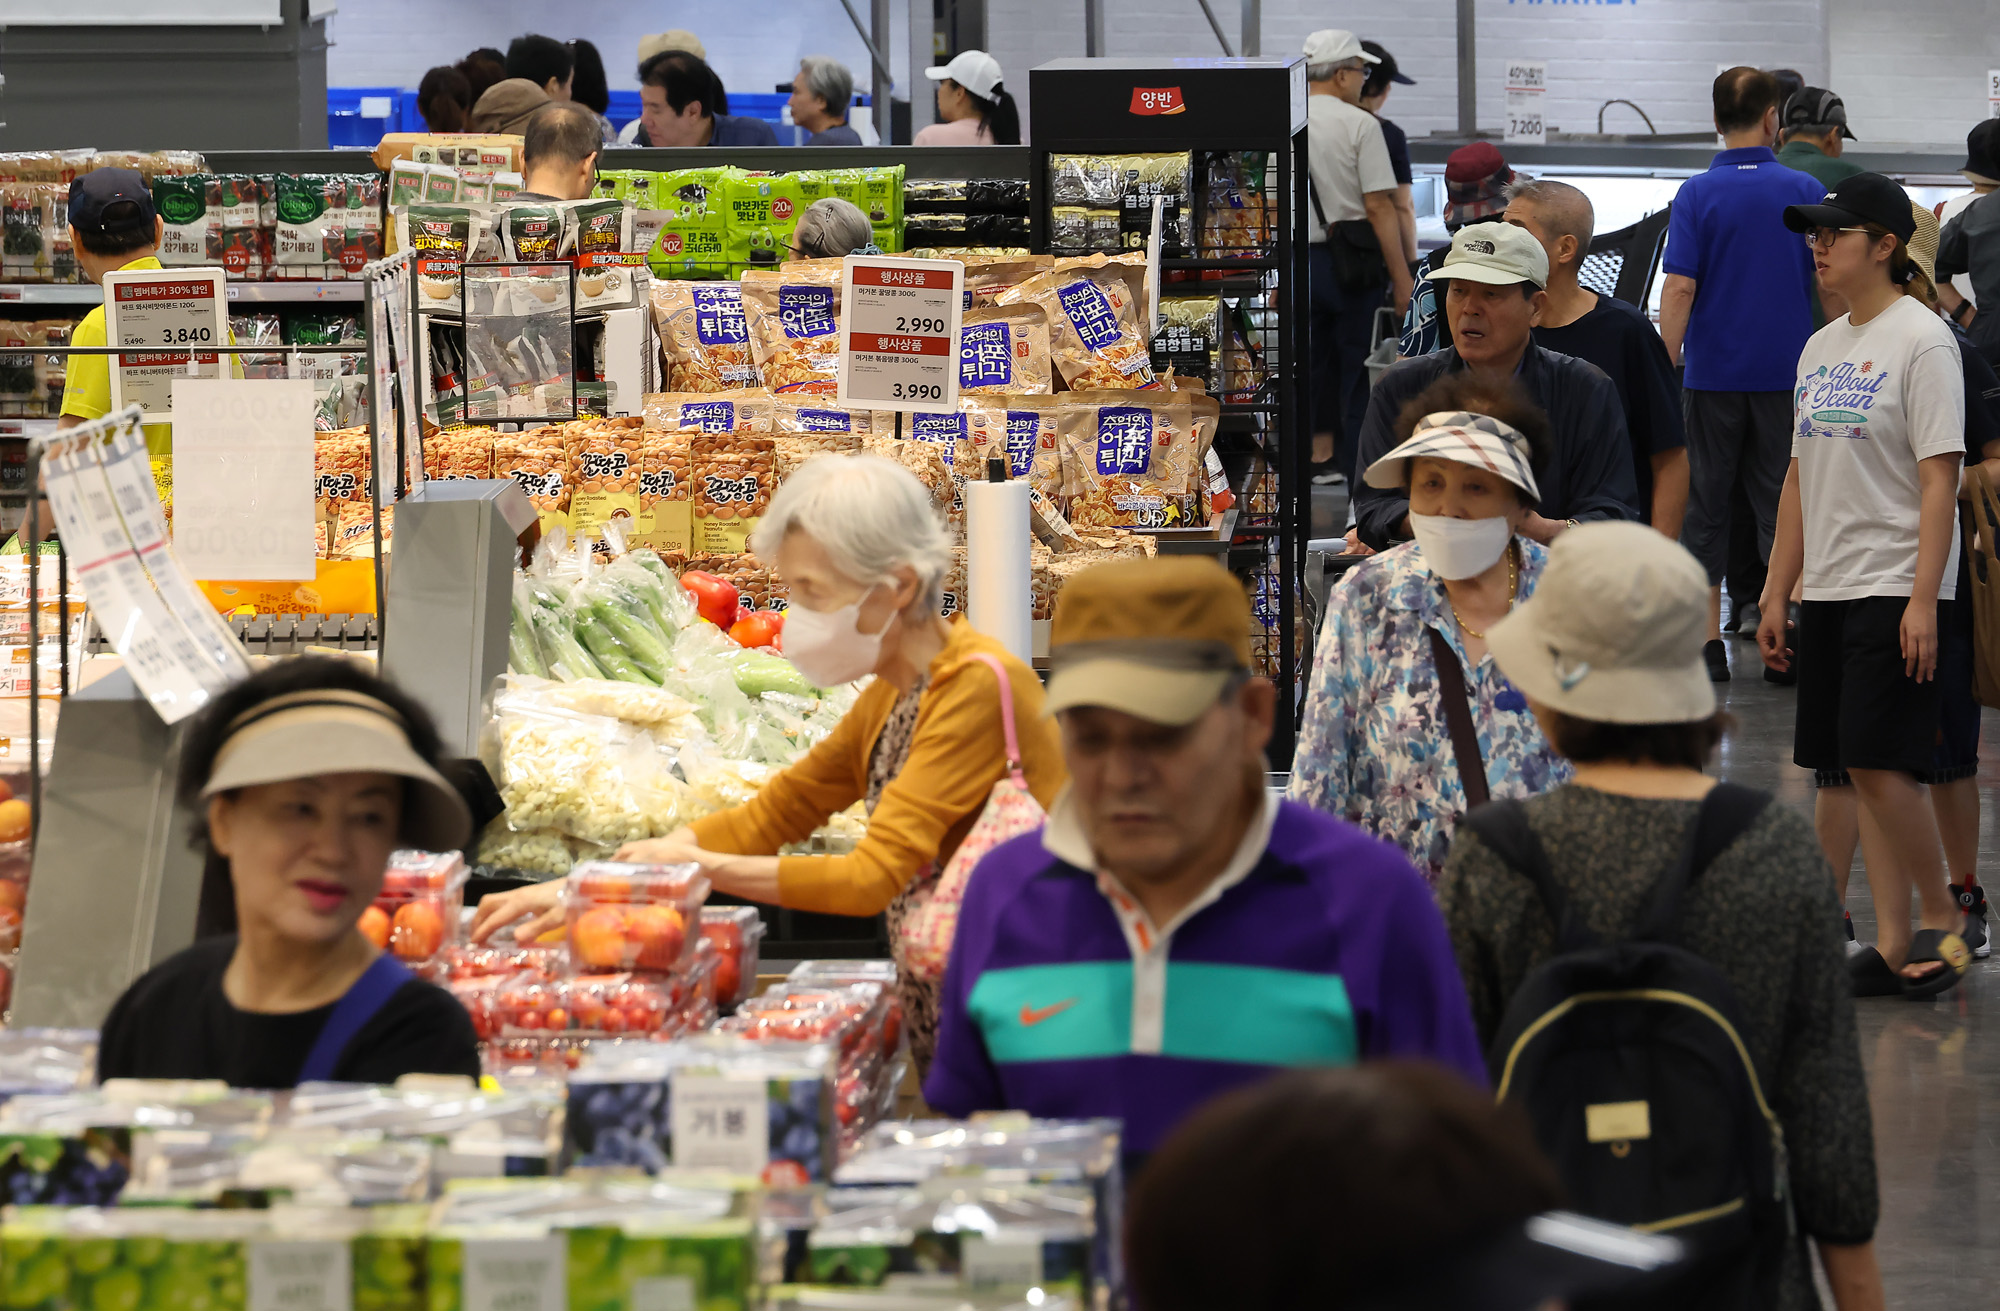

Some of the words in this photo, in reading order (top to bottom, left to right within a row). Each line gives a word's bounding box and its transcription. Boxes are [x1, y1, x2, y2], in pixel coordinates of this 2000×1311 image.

[1141, 91, 1172, 109] 양반
[483, 155, 505, 164] 대천김
[166, 199, 195, 213] bibigo
[283, 199, 313, 213] bibigo
[733, 200, 769, 211] 아보카도
[1125, 194, 1175, 208] 곱창김
[737, 211, 755, 221] 맛난
[758, 211, 766, 221] 김
[280, 229, 298, 240] 직화
[526, 223, 547, 232] 대천김
[164, 231, 181, 241] 직화
[163, 242, 199, 254] 참기름김
[280, 241, 315, 254] 참기름김
[685, 243, 721, 253] 아보카도
[880, 271, 926, 285] 행사상품
[133, 287, 167, 297] 멤버특가
[169, 286, 191, 295] 30%
[191, 285, 208, 295] 할인
[858, 288, 877, 296] 머거본
[898, 290, 916, 298] 300G
[1063, 287, 1095, 310] 추억의
[1070, 299, 1109, 324] 어포
[895, 316, 945, 333] 2,990
[1078, 316, 1118, 346] 튀각
[163, 327, 211, 345] 3,840
[963, 329, 1003, 346] 추억의
[1168, 326, 1190, 338] 광천
[877, 337, 923, 351] 행사상품
[855, 354, 874, 362] 머거본
[961, 343, 1007, 362] 어포
[962, 361, 1008, 381] 튀각
[1829, 361, 1889, 393] About
[892, 383, 941, 400] 3,990
[1811, 382, 1876, 410] Ocean
[685, 405, 729, 420] 추억의
[918, 418, 960, 433] 추억의
[1103, 415, 1147, 429] 추억의
[1100, 446, 1147, 468] 튀각
[580, 452, 628, 478] 꿀땅콩
[705, 476, 758, 503] 꿀땅콩
